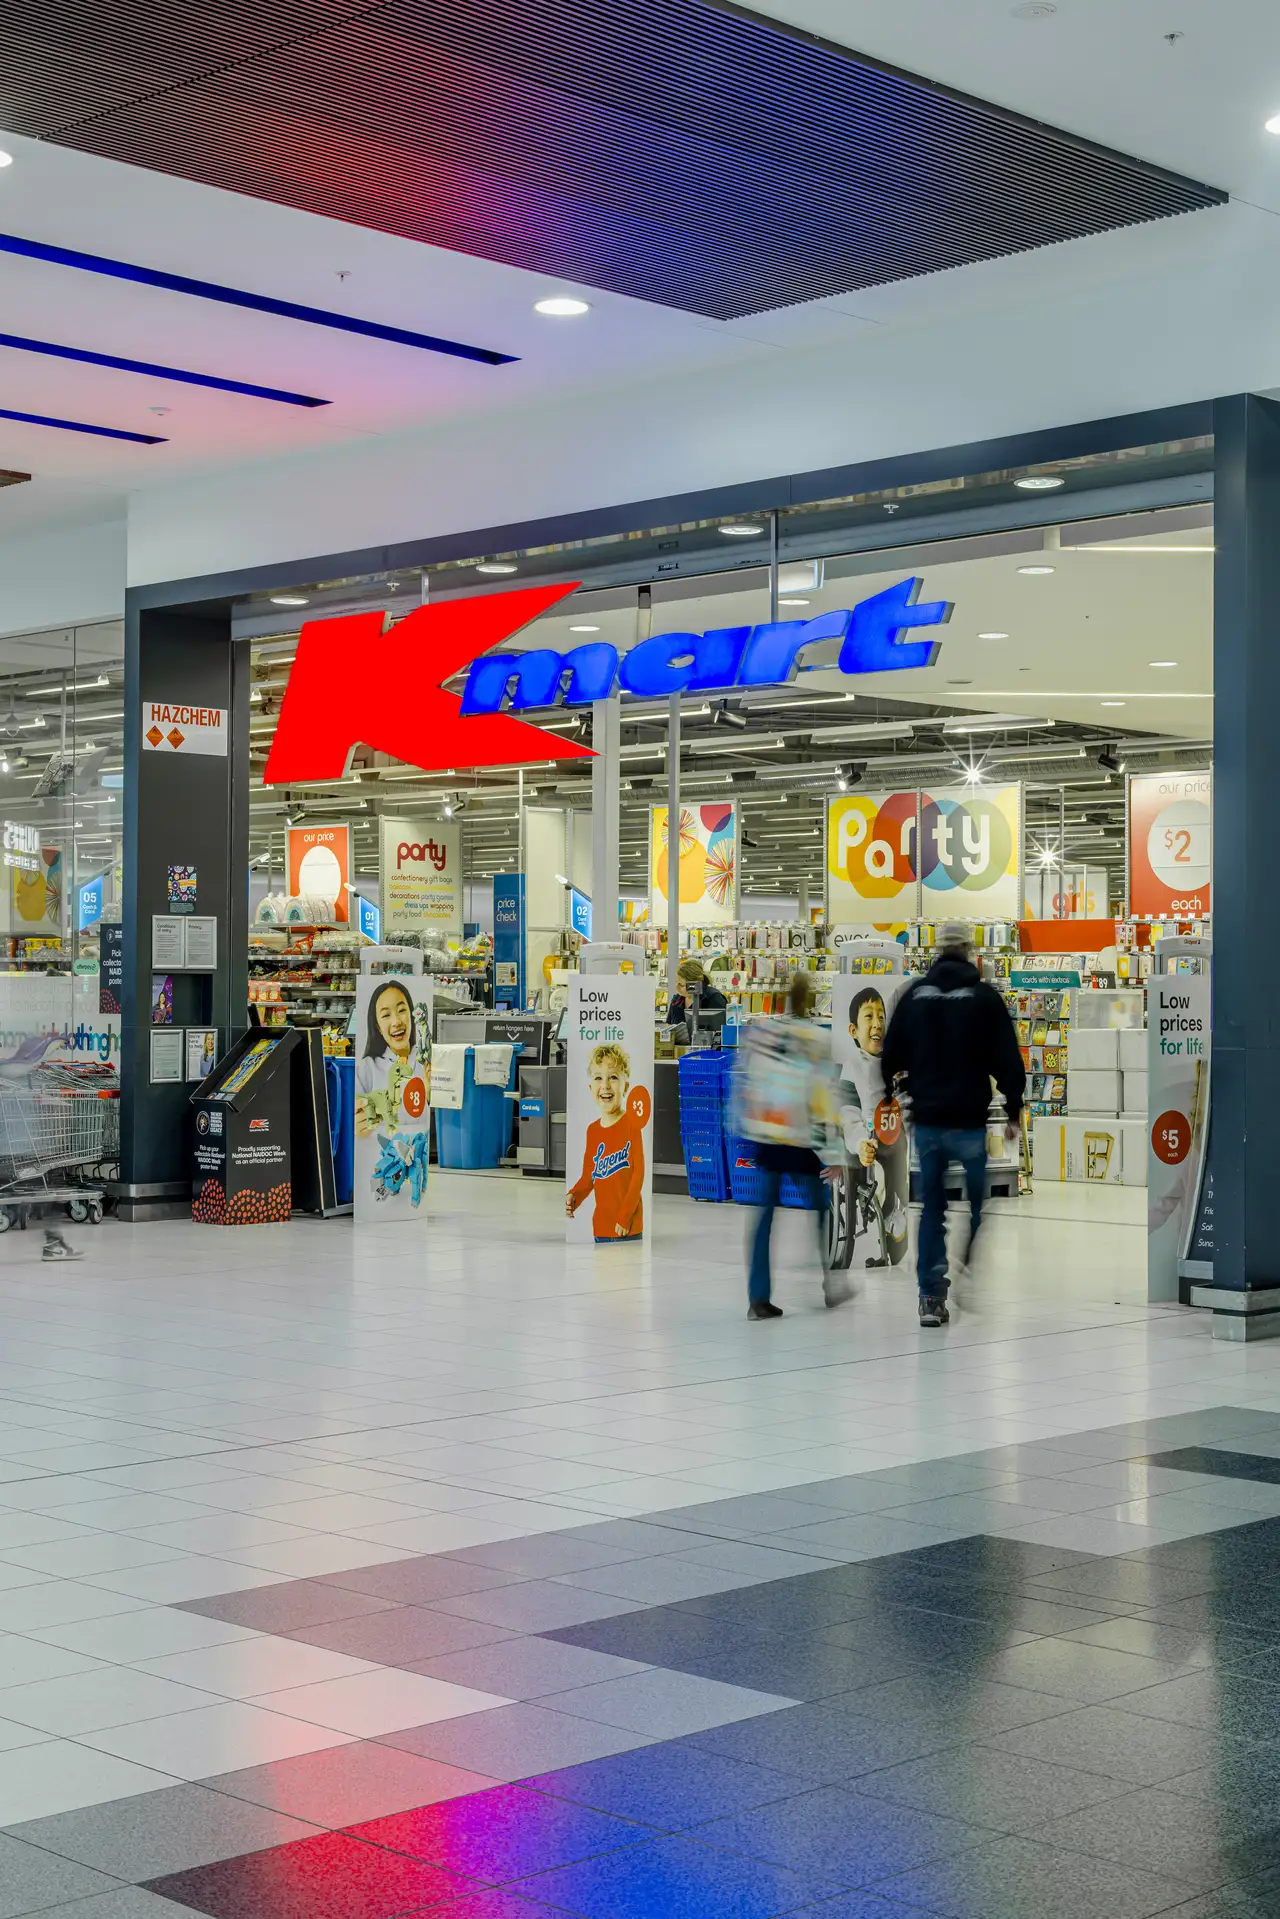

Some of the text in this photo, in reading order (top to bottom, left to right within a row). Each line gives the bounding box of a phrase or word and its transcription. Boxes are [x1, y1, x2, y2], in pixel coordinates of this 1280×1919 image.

[263, 576, 955, 785] Kmart
[151, 704, 221, 728] HAZCHEM
[1158, 781, 1180, 795] our
[303, 831, 335, 844] our price
[1164, 829, 1191, 862] $2
[396, 838, 447, 872] party
[391, 874, 429, 884] confectionery
[439, 875, 453, 885] bags
[83, 892, 97, 903] 05
[389, 891, 420, 900] decorations
[1052, 880, 1095, 920] girls
[1171, 895, 1202, 911] each
[404, 901, 418, 909] dress
[430, 903, 454, 912] wrapping
[498, 897, 516, 912] price
[576, 906, 588, 916] 02
[365, 911, 374, 920] 01
[392, 910, 408, 919] party
[496, 910, 517, 922] check
[702, 930, 725, 948] est
[111, 949, 122, 957] Pick
[1022, 976, 1038, 984] cards
[1038, 976, 1050, 984] with
[580, 988, 608, 1002] Low
[1160, 991, 1190, 1009] Low
[580, 1006, 622, 1024] prices
[506, 1024, 523, 1033] hangers
[1160, 1014, 1203, 1036] prices
[579, 1026, 624, 1040] for life
[1160, 1038, 1182, 1055] for
[410, 1091, 420, 1106] $8
[632, 1100, 644, 1117] $3
[1162, 1129, 1179, 1150] $5
[592, 1141, 632, 1181] Legend
